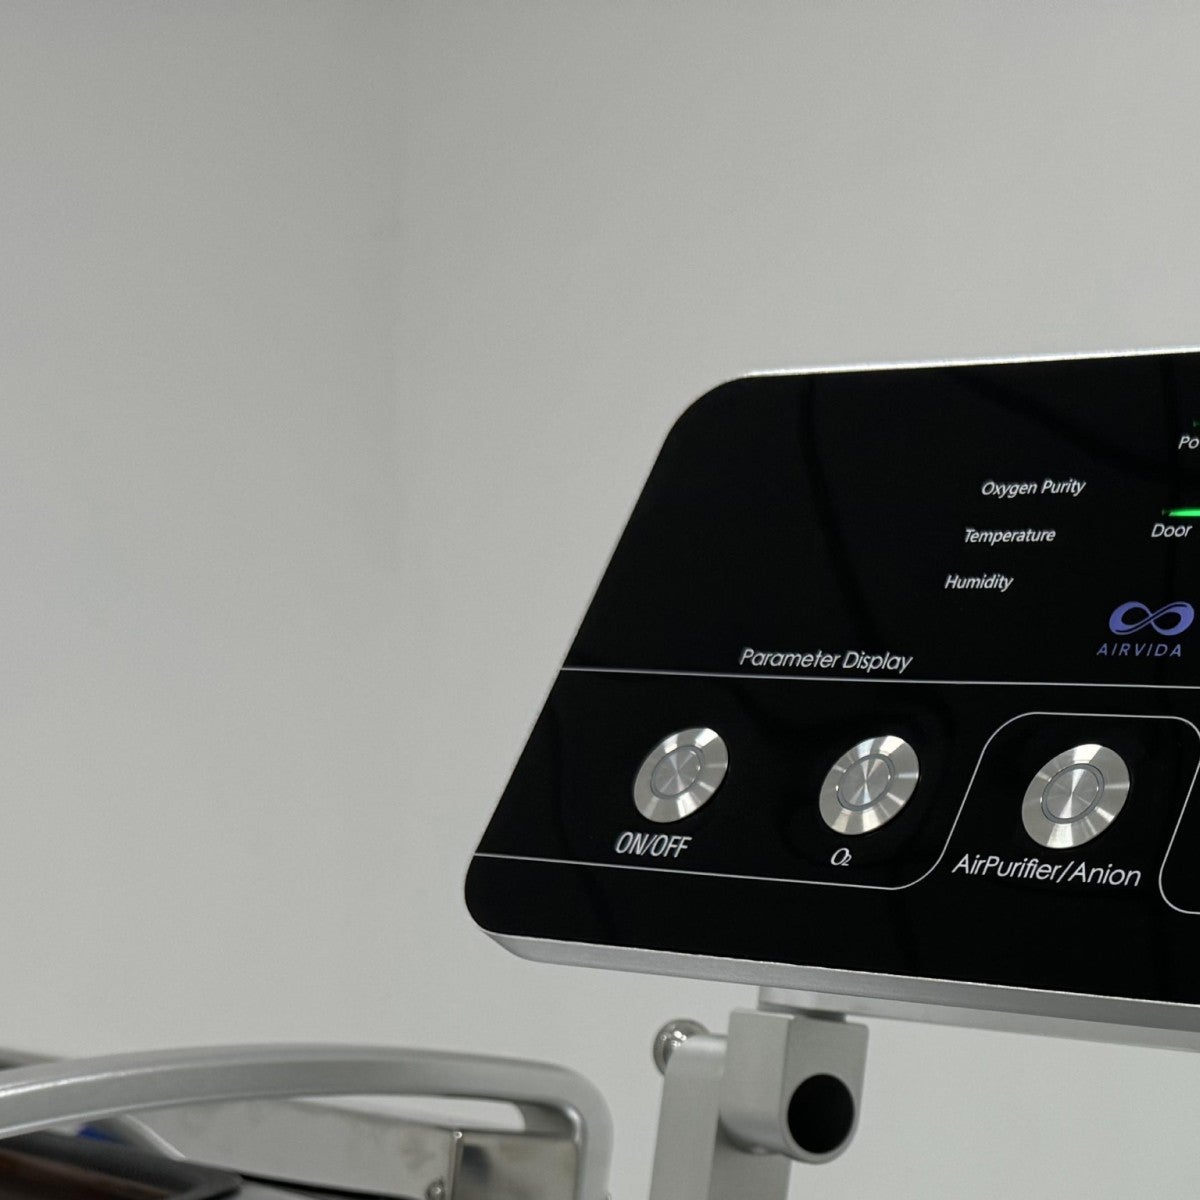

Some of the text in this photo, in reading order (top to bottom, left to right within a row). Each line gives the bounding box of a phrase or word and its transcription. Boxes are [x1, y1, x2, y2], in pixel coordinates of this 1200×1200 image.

[982, 478, 1086, 499] Oxygen Purity
[965, 528, 1056, 546] Temperature
[1151, 523, 1193, 537] Door
[945, 574, 1014, 592] Humidity
[1097, 643, 1181, 657] AIRVIDA
[740, 648, 913, 673] Parameter Display
[615, 831, 692, 858] ON/OFF
[952, 854, 1141, 886] AirPurifier/Anion
